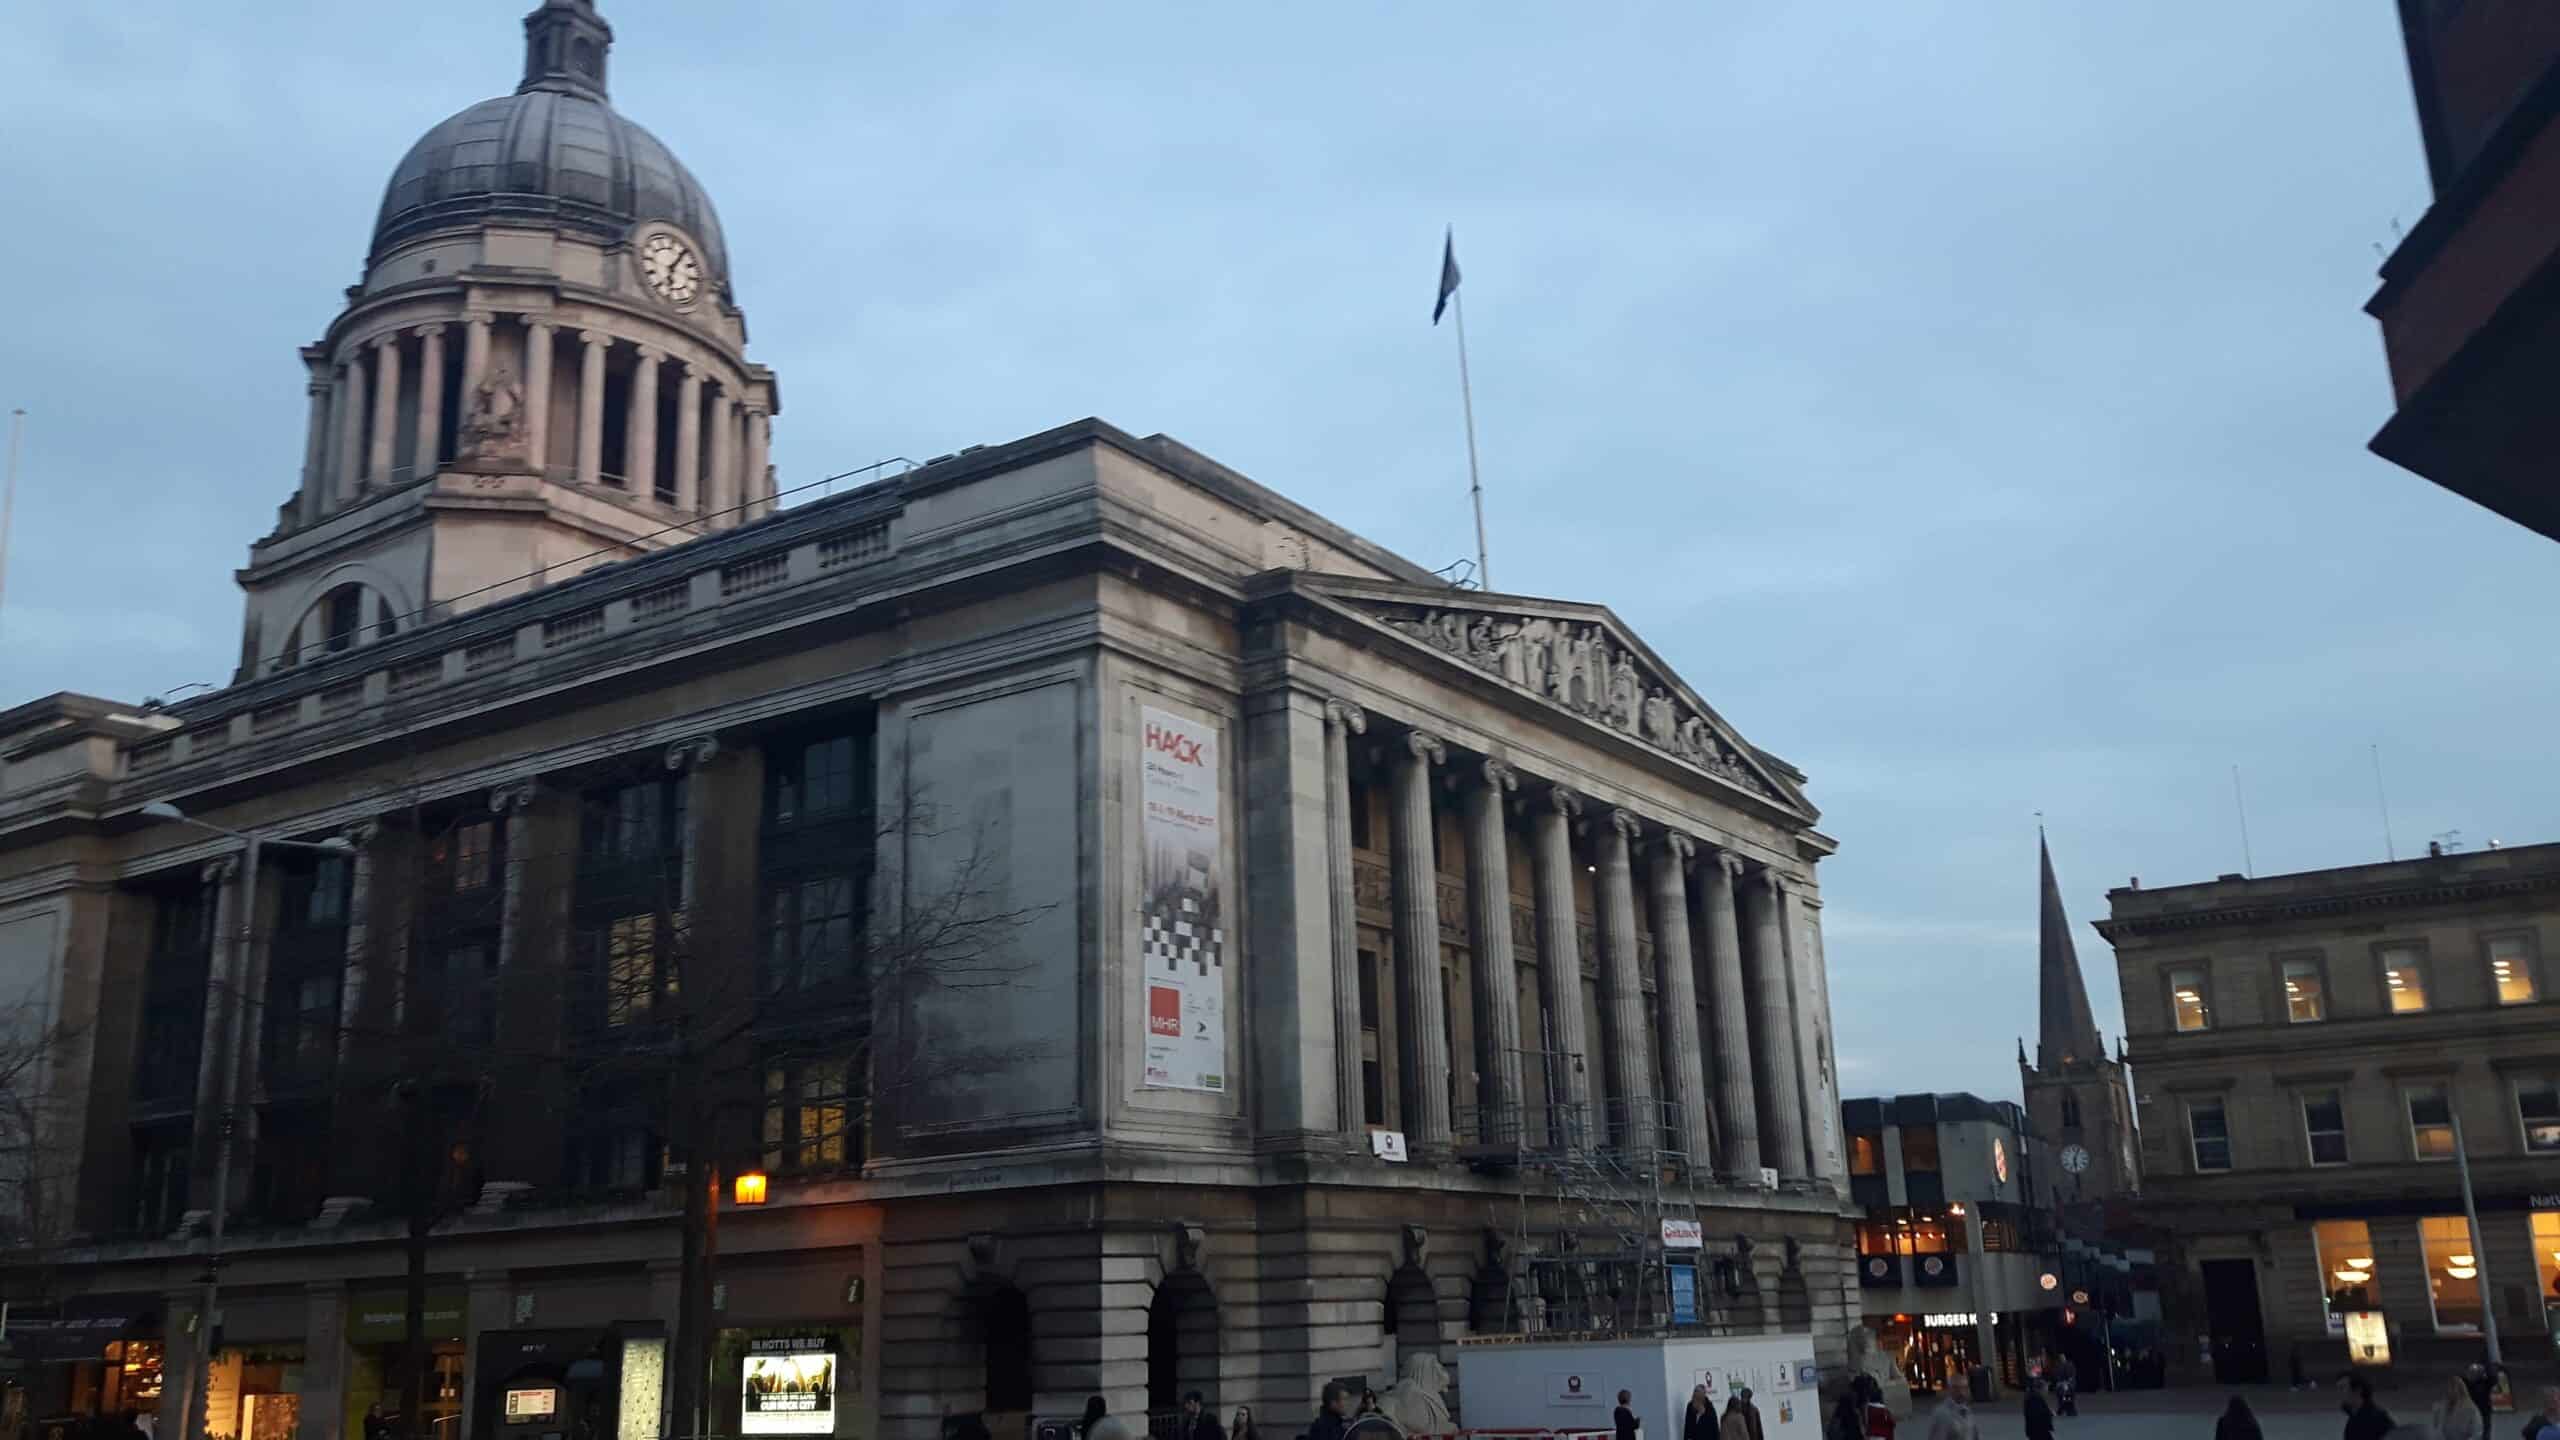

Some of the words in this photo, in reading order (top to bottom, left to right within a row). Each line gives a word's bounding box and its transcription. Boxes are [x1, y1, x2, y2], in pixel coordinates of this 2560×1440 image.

[1145, 723, 1204, 767] HACK
[1152, 1015, 1179, 1031] MHR
[1924, 1312, 1968, 1327] BURGER
[1968, 1311, 1999, 1326] KG
[799, 1400, 817, 1410] CITY
